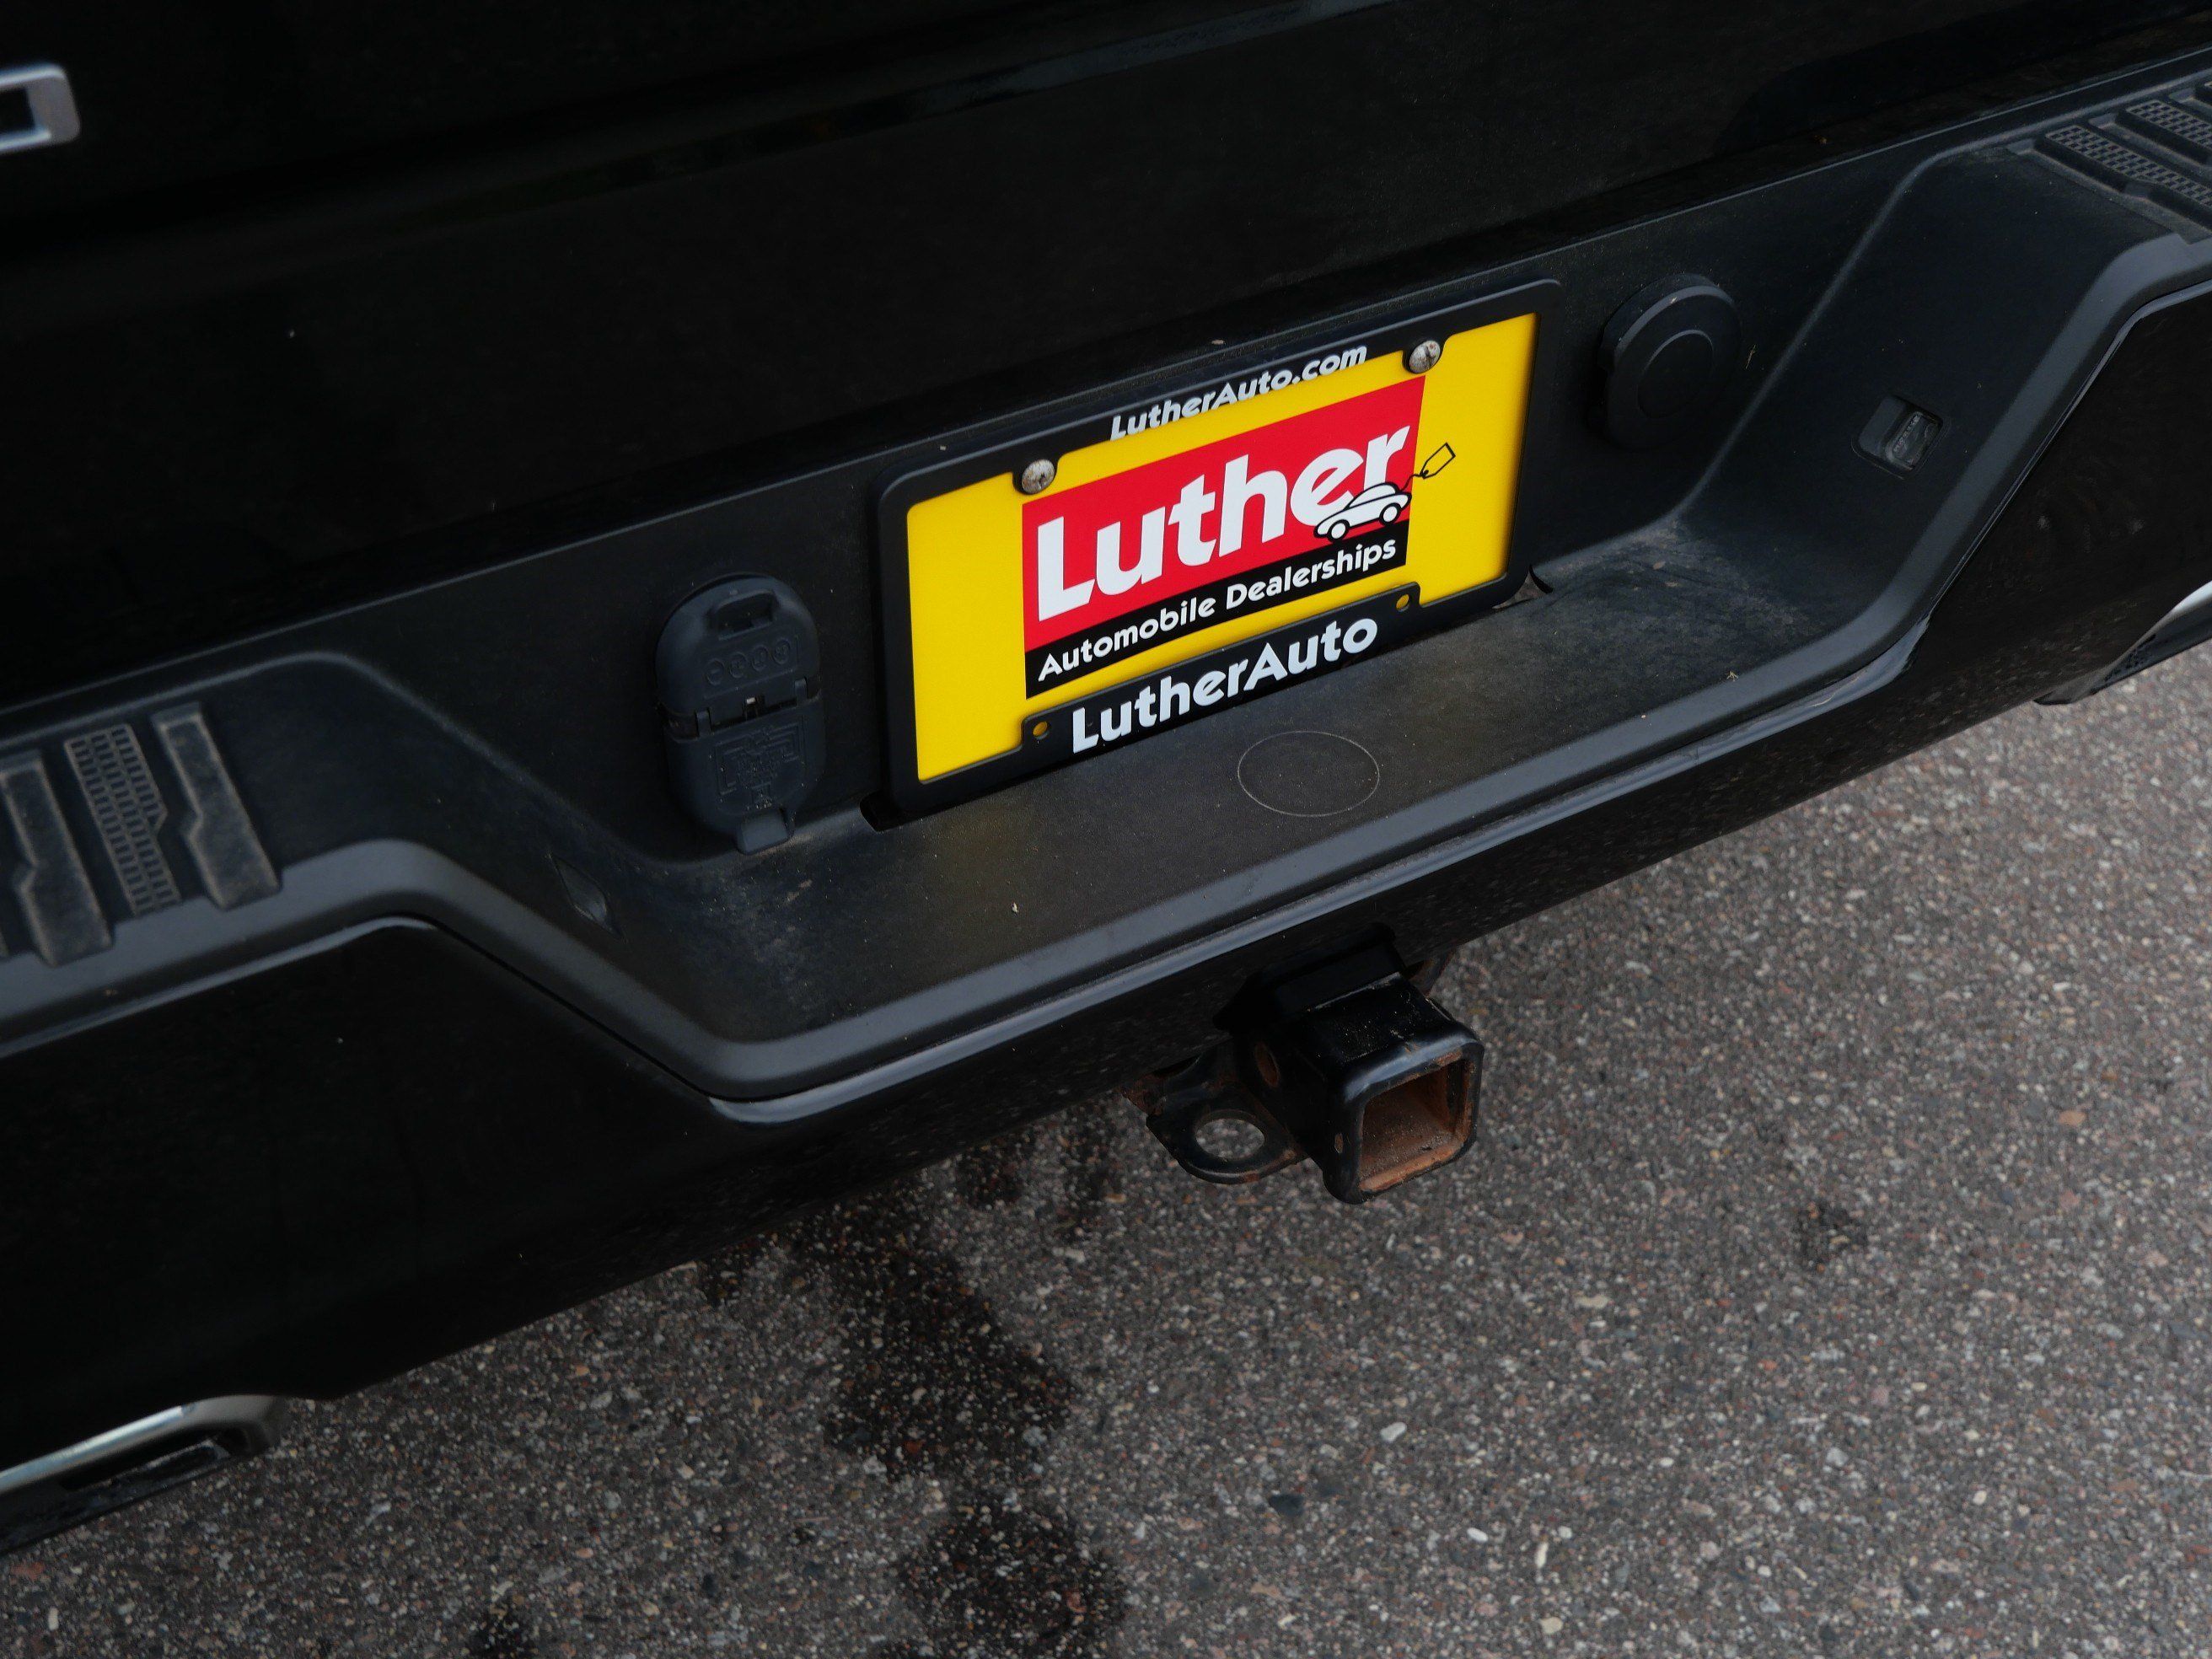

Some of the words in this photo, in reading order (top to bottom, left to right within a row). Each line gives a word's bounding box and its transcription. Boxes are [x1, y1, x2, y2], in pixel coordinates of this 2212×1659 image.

[1109, 346, 1367, 441] LutherAuto.com
[1037, 425, 1410, 622] Luther
[1037, 597, 1216, 682] Automobile
[1226, 539, 1396, 609] Dealerships
[1071, 618, 1377, 754] LutherAuto
